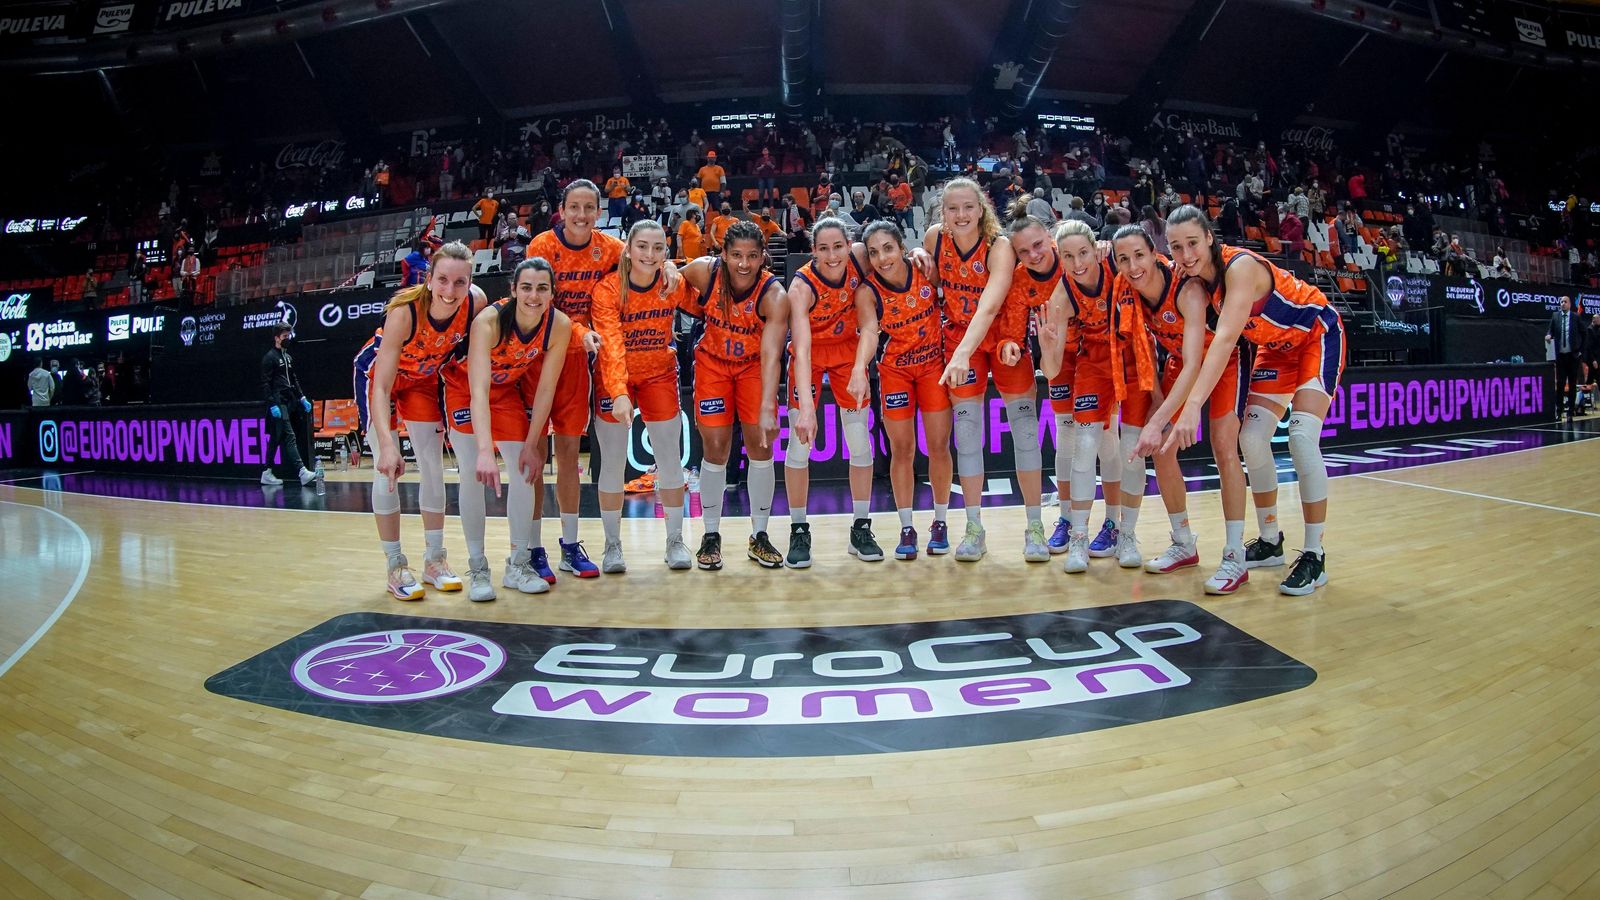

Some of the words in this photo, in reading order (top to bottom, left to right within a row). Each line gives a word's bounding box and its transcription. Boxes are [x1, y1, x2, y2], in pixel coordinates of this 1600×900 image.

[100, 8, 131, 17] PULEVA
[0, 15, 65, 34] PULEVA
[1517, 21, 1541, 33] PULEVA
[1037, 114, 1095, 123] PORSCHE
[545, 112, 636, 137] CaaBank
[1166, 114, 1243, 138] CaixaBank
[558, 270, 592, 281] ENCIA
[1406, 278, 1431, 287] valencia
[1406, 288, 1427, 296] basket
[1406, 296, 1423, 304] club
[1512, 292, 1562, 304] gesternov
[243, 311, 282, 322] L'ALQUERIA
[348, 302, 386, 320] ges
[199, 313, 226, 323] valencia
[885, 304, 934, 330] VALENCIA
[45, 319, 76, 334] caixa
[199, 323, 221, 332] basket
[243, 321, 254, 330] DEL
[255, 319, 281, 329] BASKET
[833, 320, 845, 335] 8
[44, 331, 93, 350] popular
[199, 333, 215, 341] club
[624, 338, 665, 347] sfuerzo
[725, 337, 745, 357] 18
[895, 346, 940, 367] Esfuerzo
[886, 393, 908, 401] PULEVA
[1075, 395, 1097, 405] PULEVA
[700, 399, 724, 407] PULEVA
[1320, 376, 1544, 438] @EUROCUPWOMEN
[533, 621, 1204, 681] EuroCup
[528, 663, 1173, 720] women
